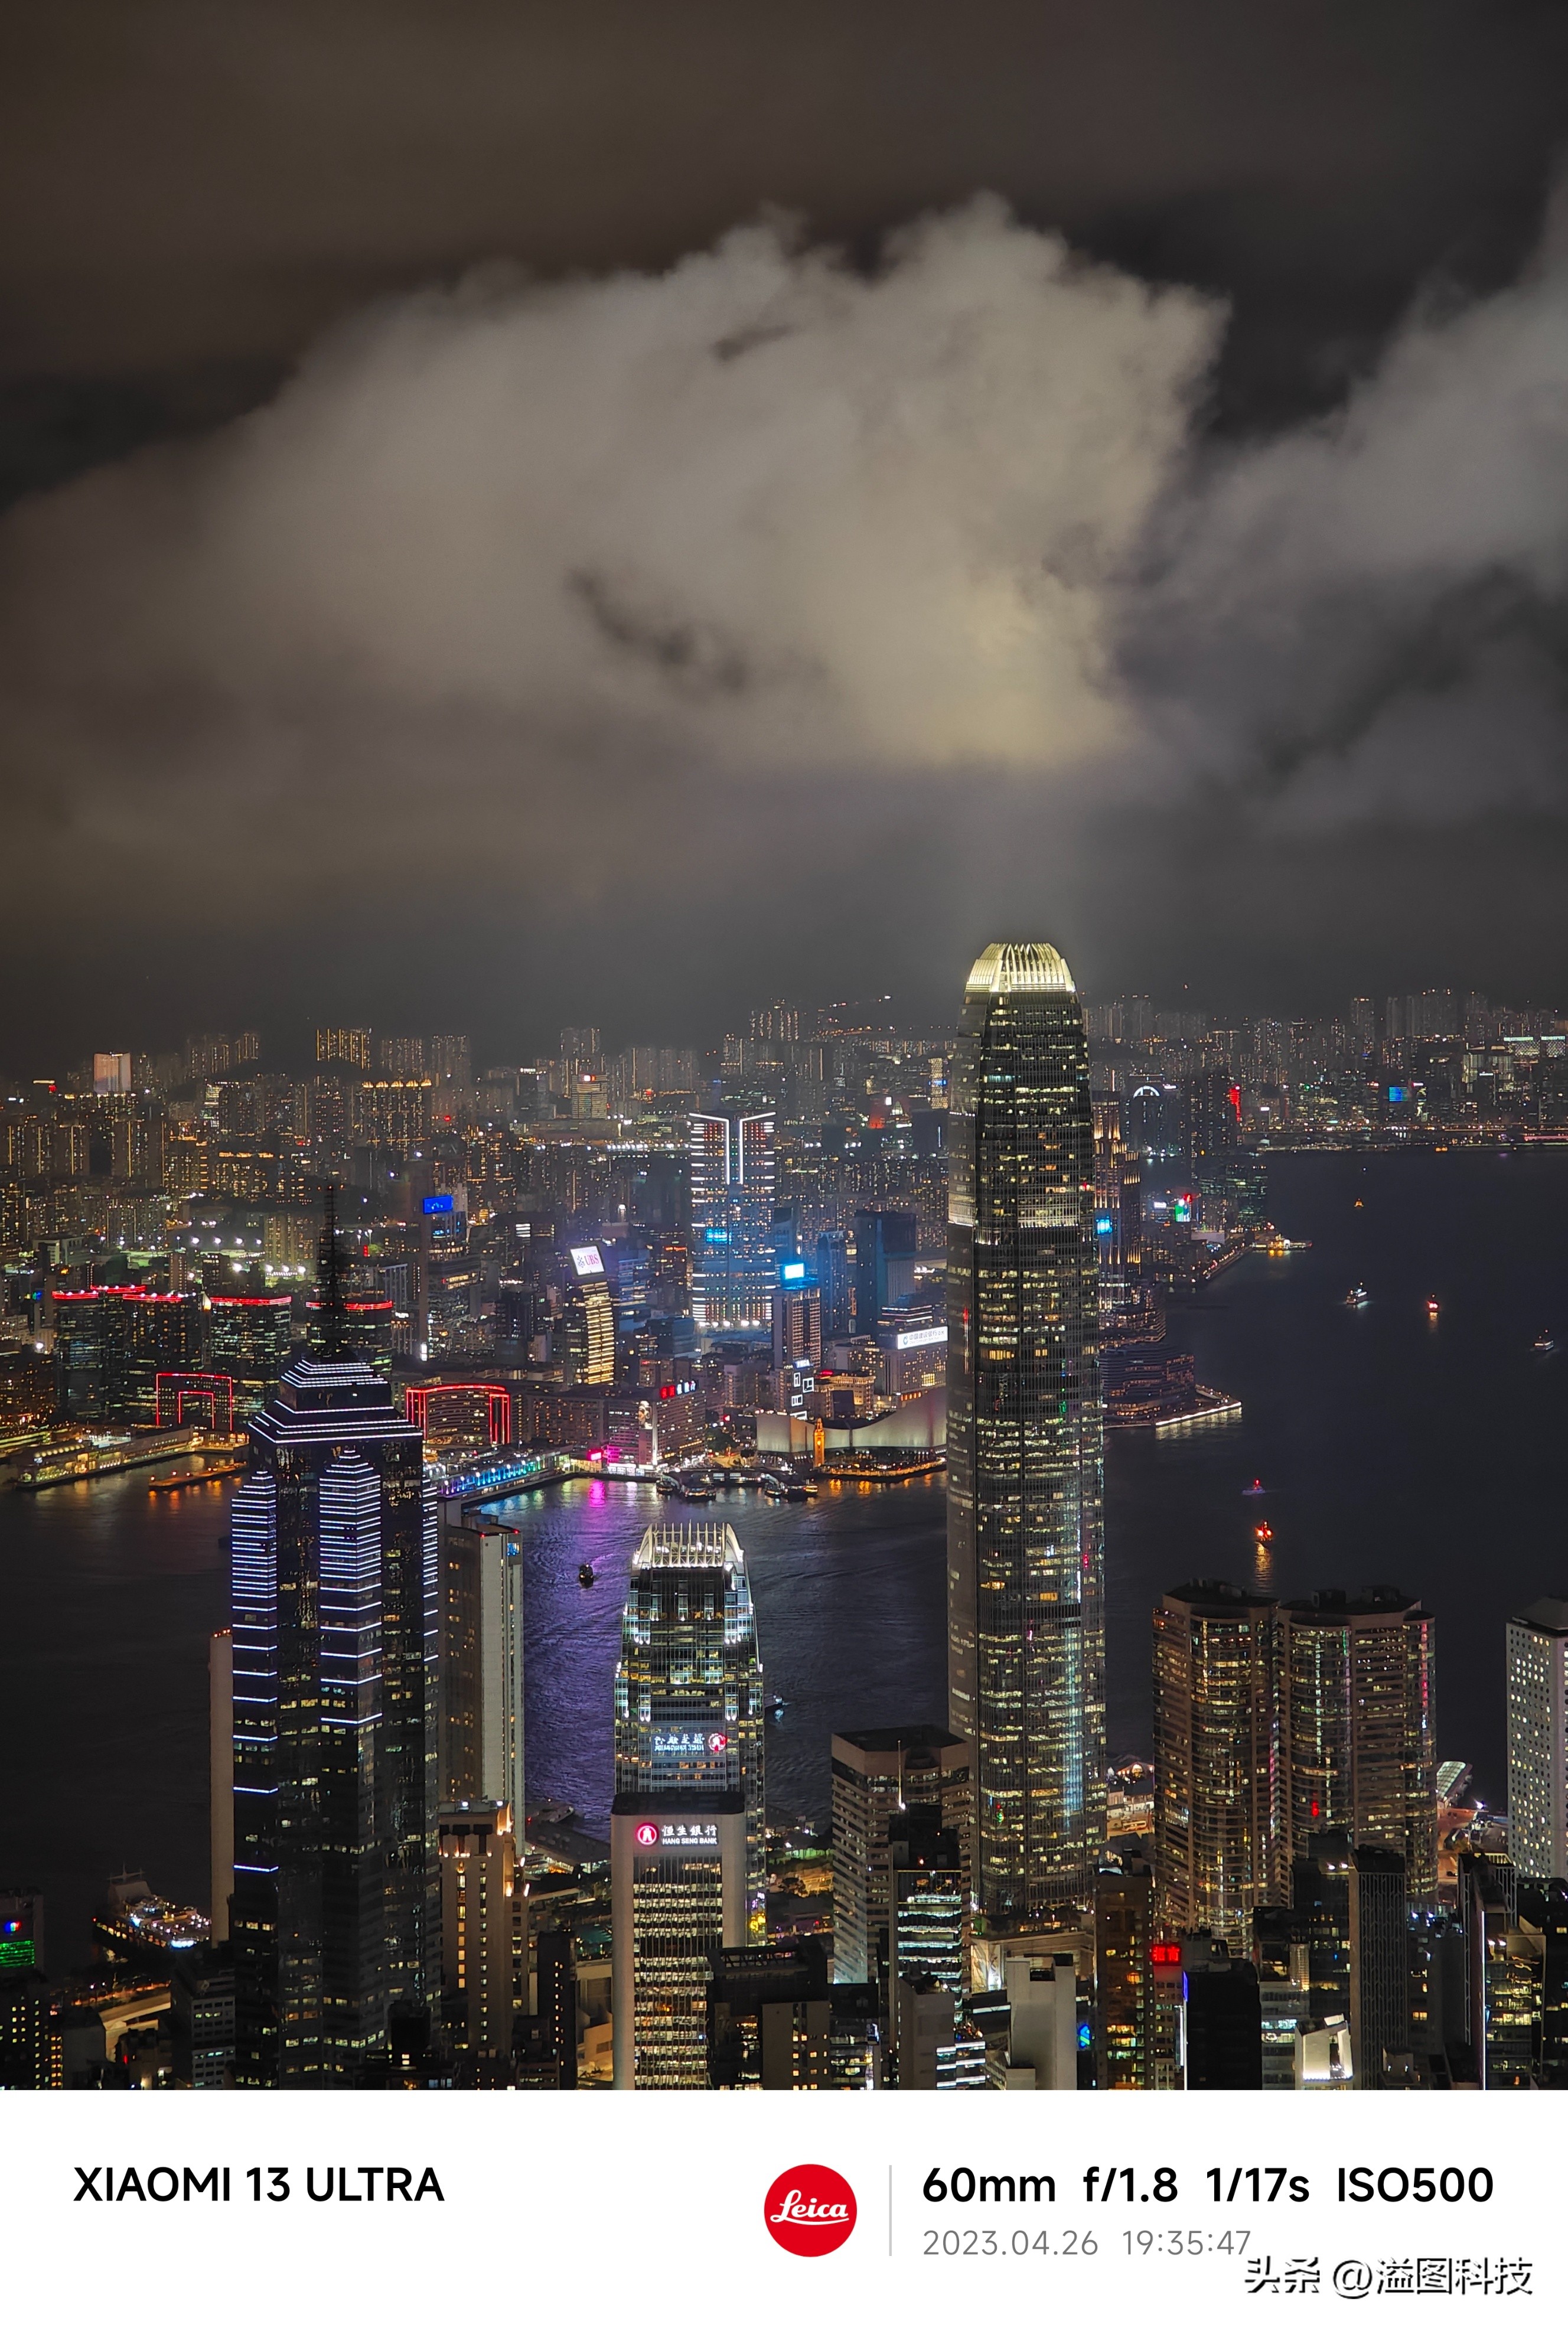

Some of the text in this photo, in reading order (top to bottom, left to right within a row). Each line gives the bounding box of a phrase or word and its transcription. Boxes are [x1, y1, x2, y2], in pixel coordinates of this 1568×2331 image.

[584, 1254, 599, 1265] UBS
[661, 1824, 718, 1837] 恒生銀行
